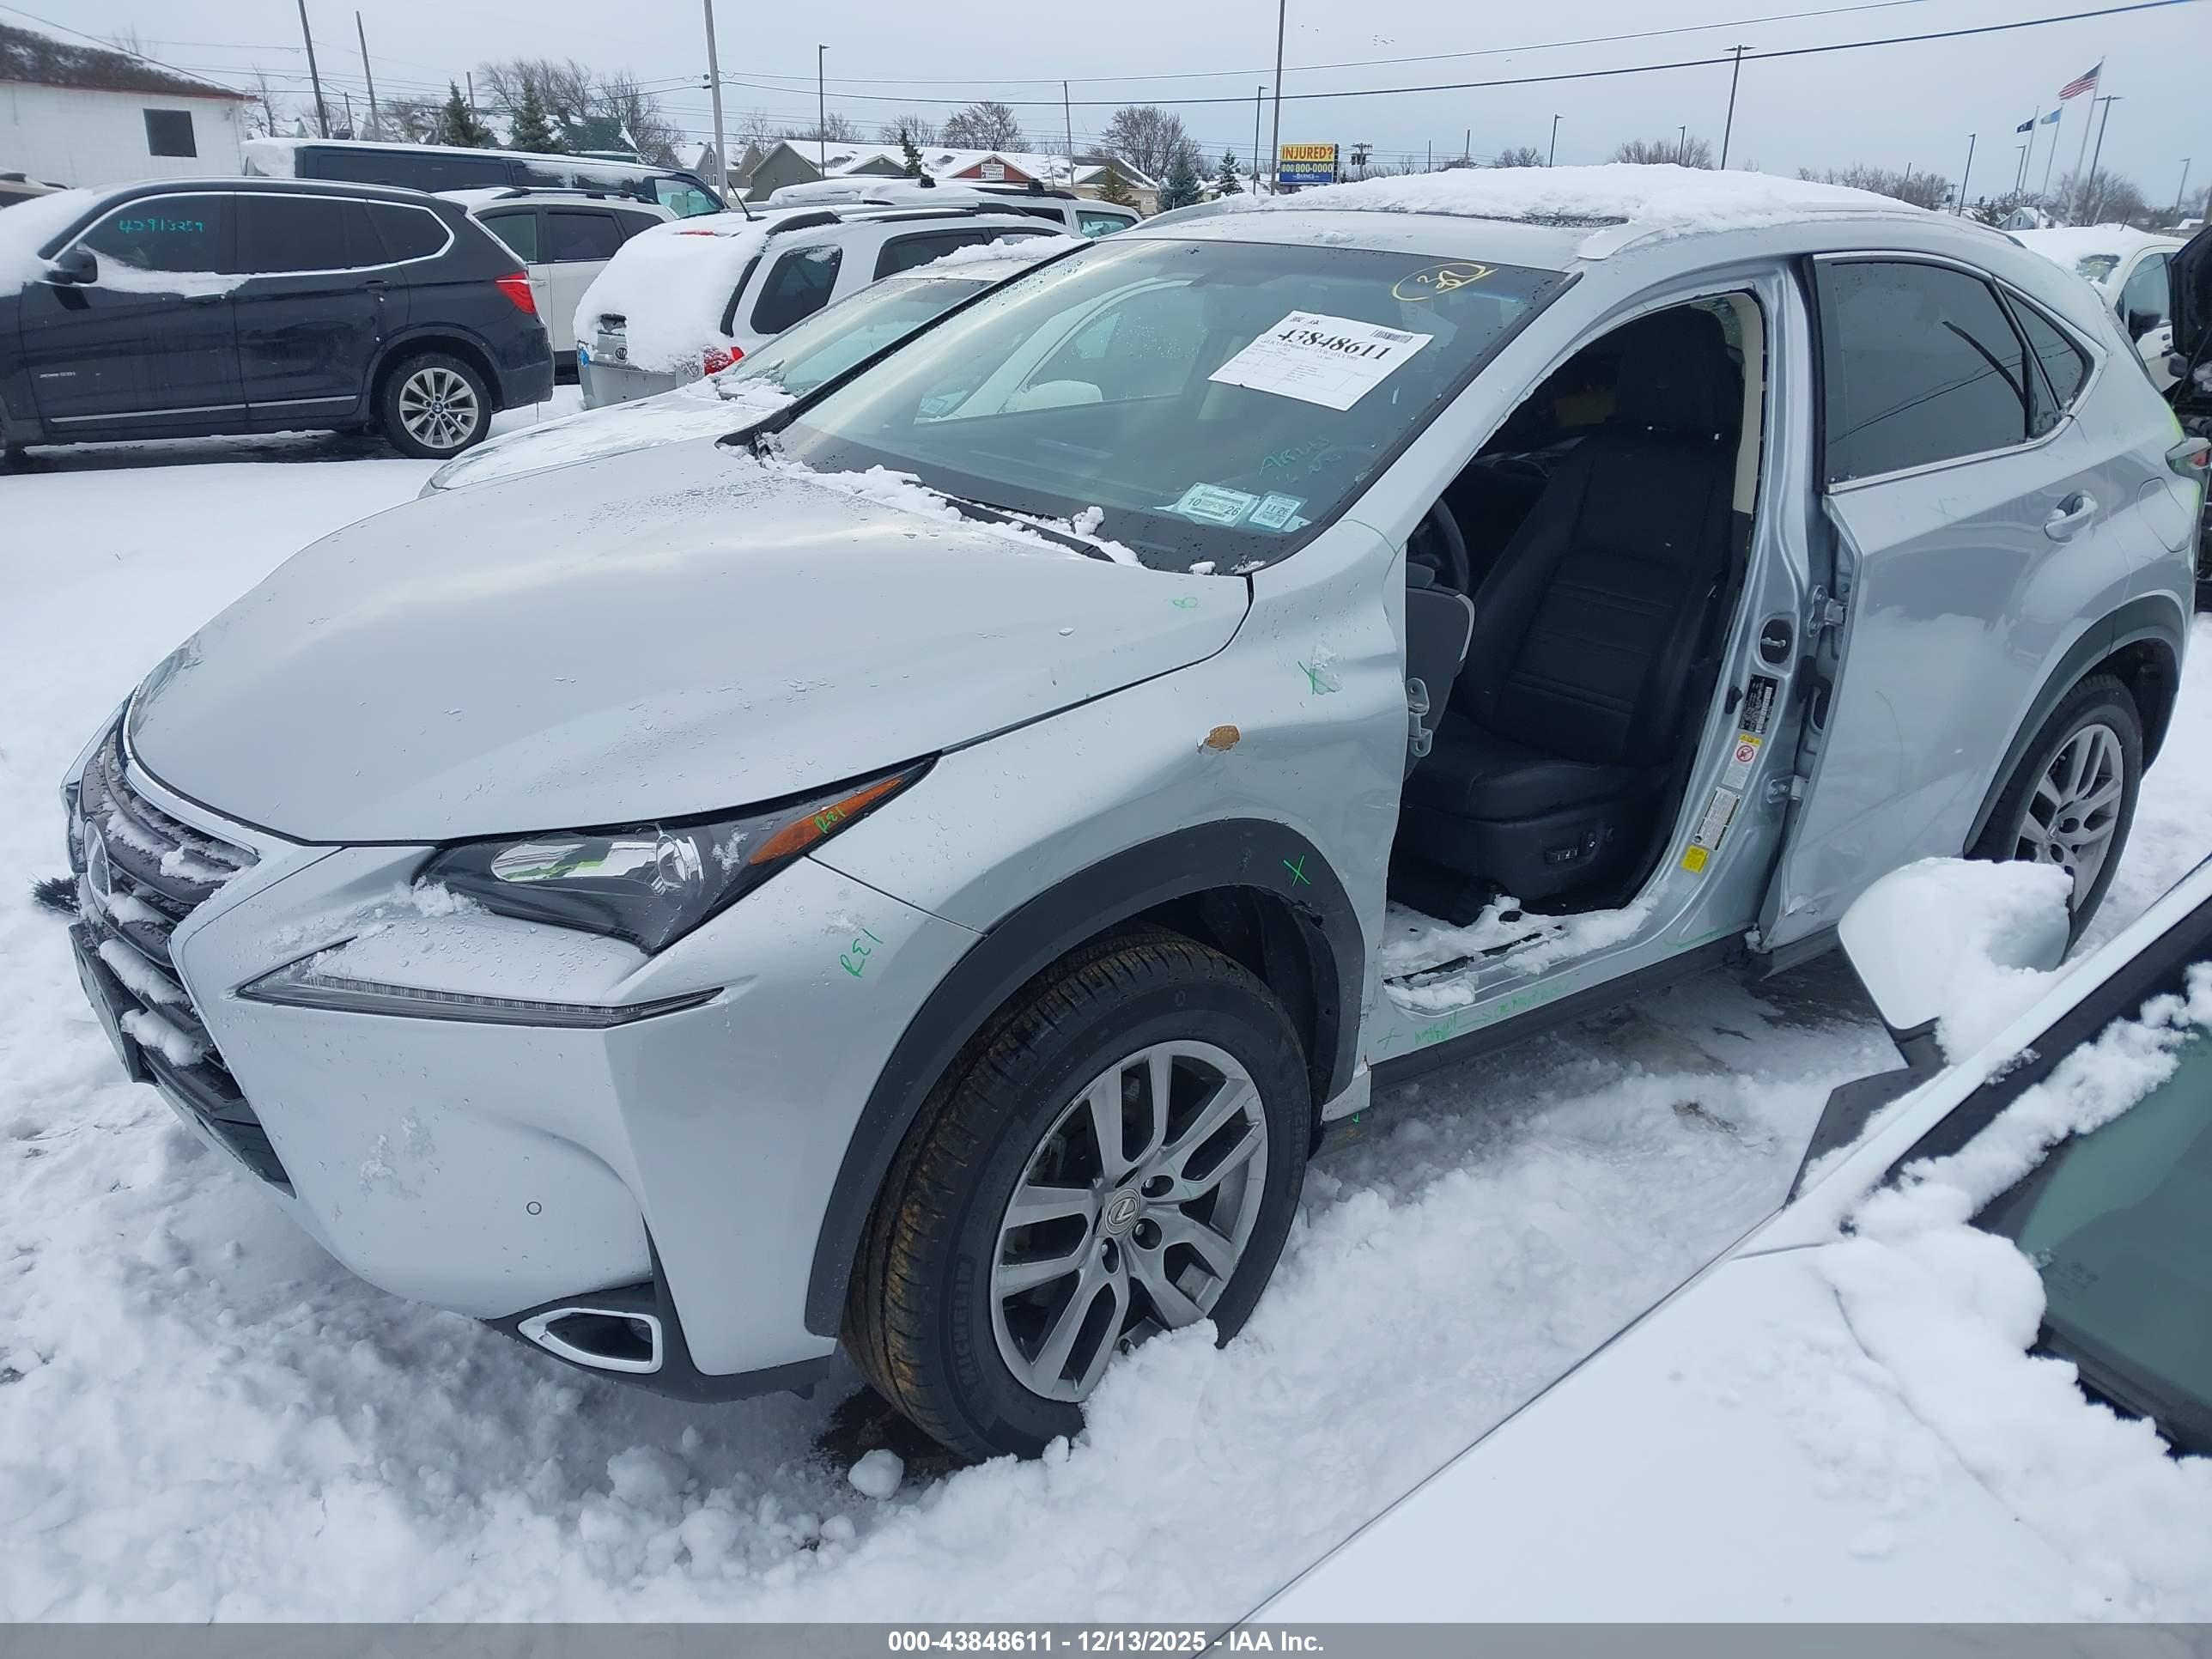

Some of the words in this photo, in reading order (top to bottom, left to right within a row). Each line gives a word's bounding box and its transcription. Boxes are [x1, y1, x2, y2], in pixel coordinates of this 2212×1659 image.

[1282, 146, 1334, 160] INJURED?
[1277, 329, 1393, 360] 43848611
[1224, 506, 1241, 516] 26
